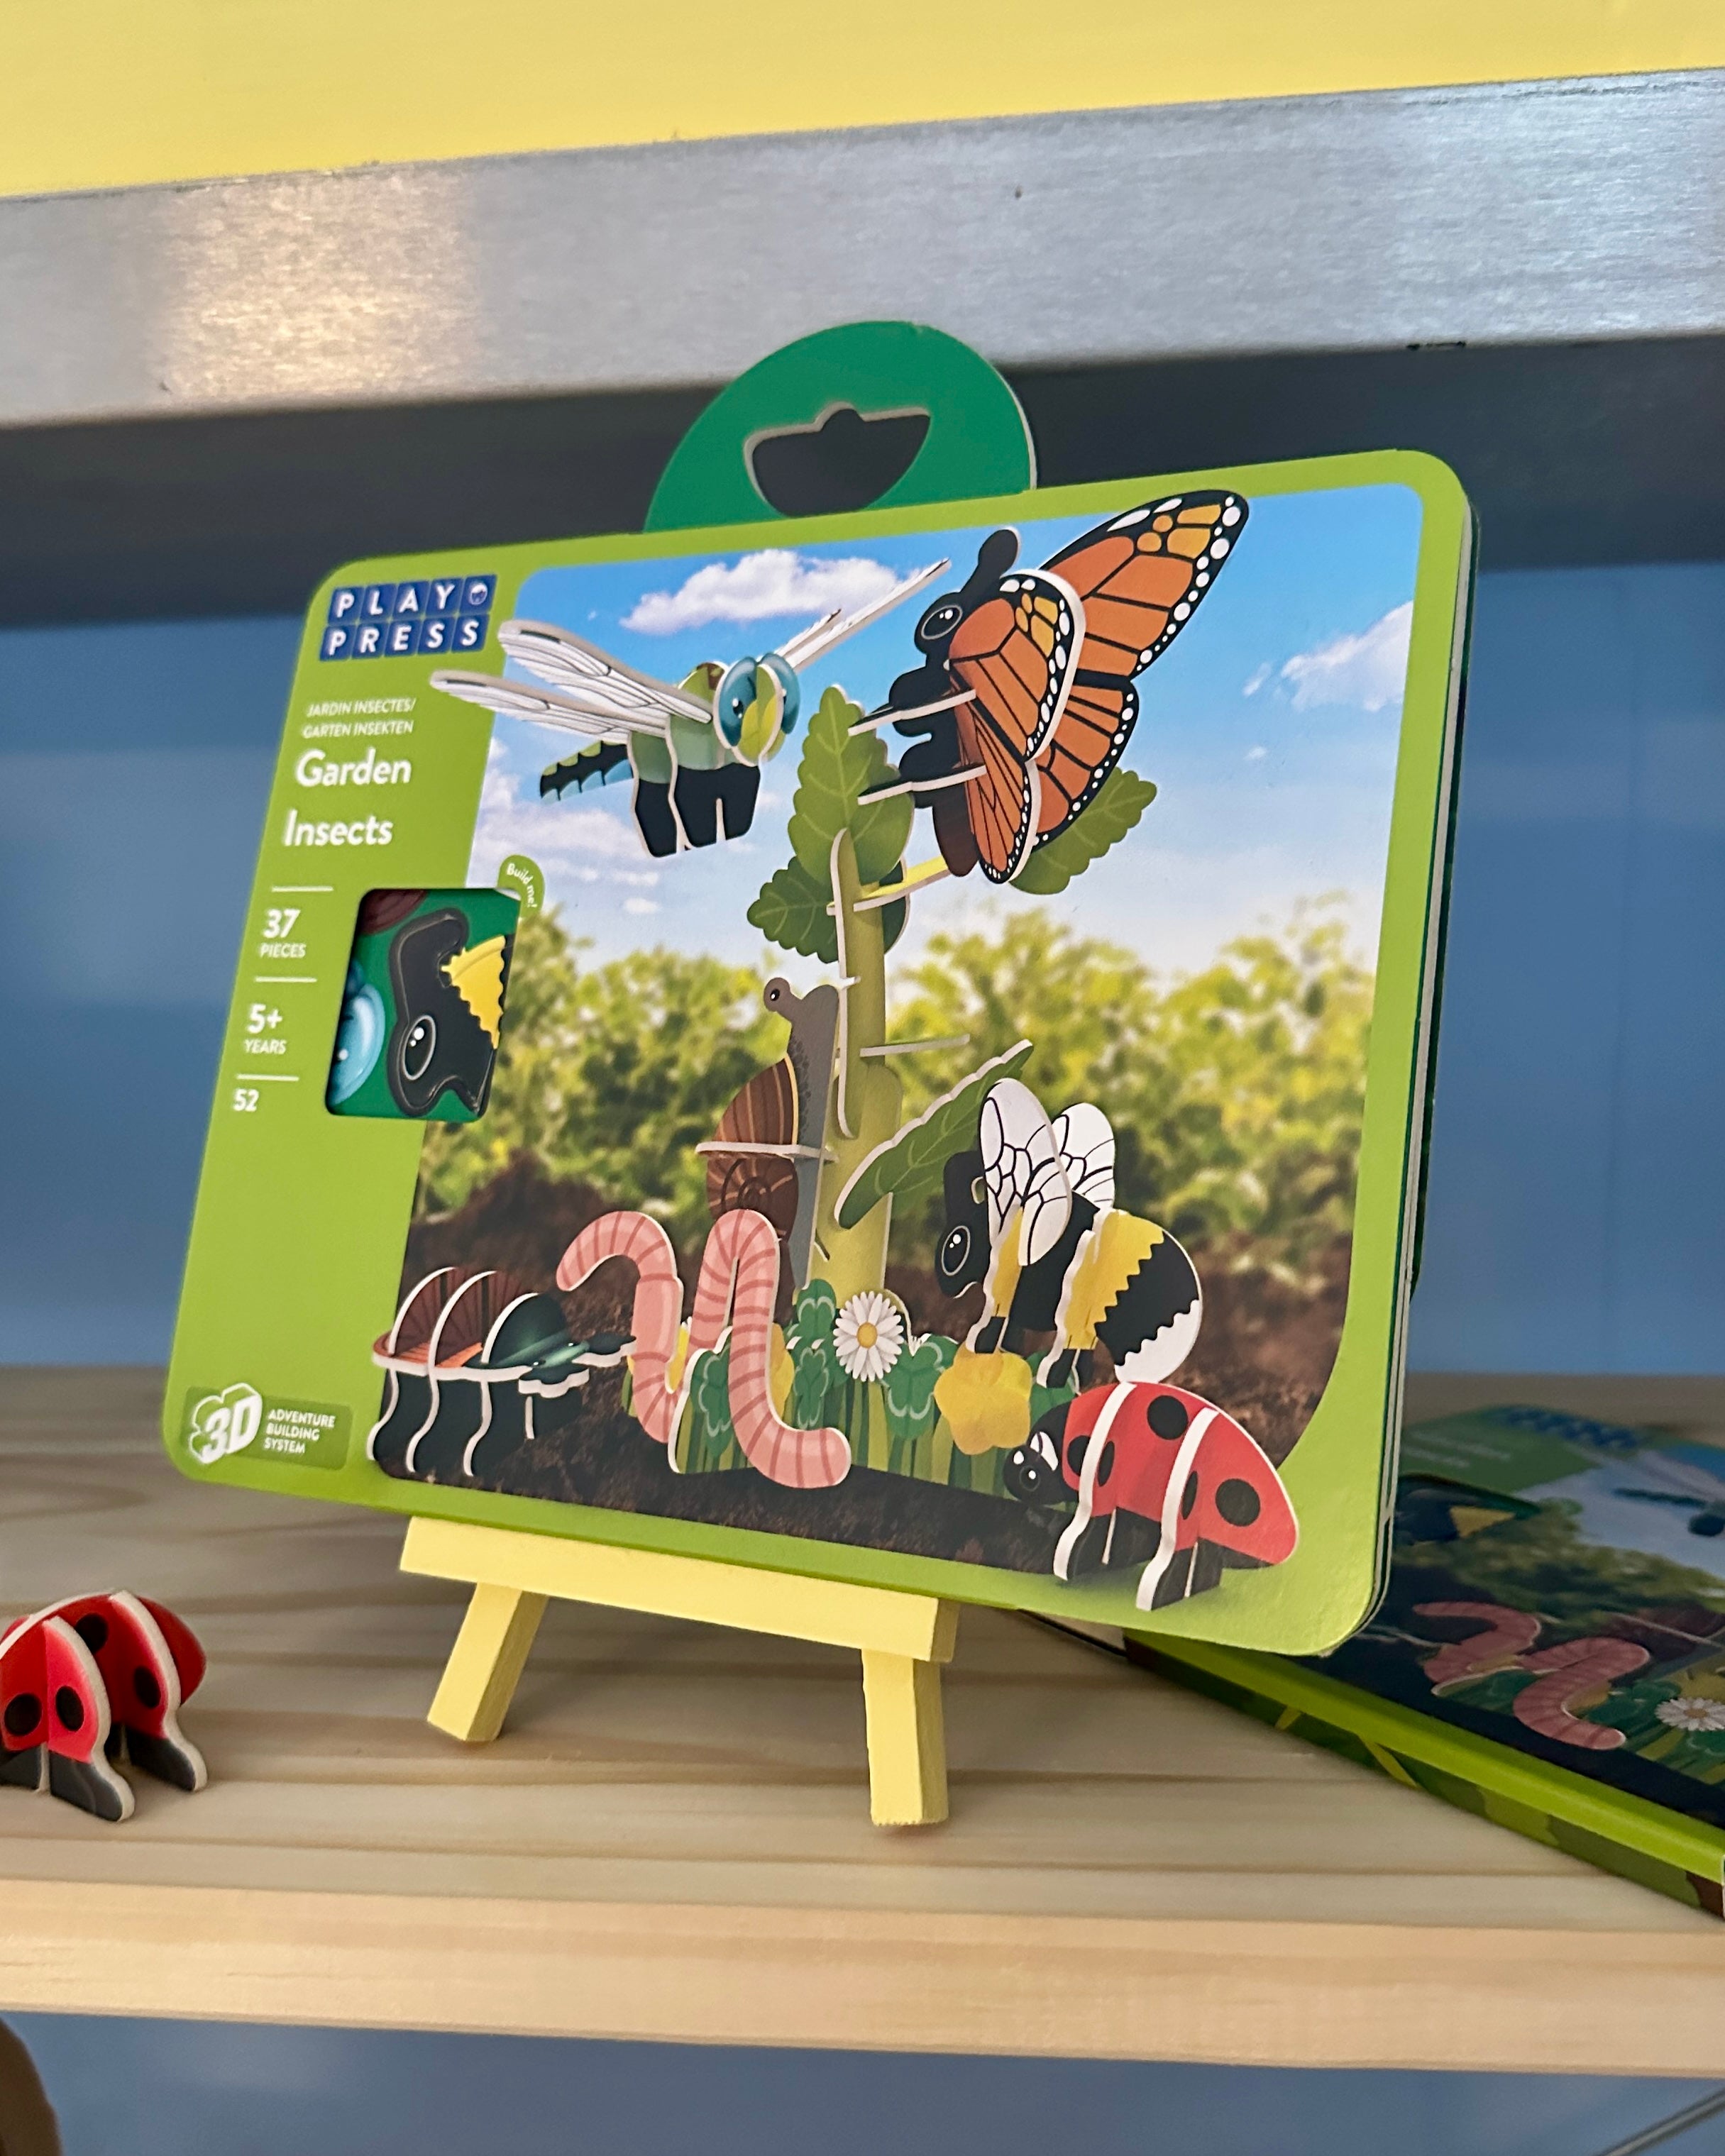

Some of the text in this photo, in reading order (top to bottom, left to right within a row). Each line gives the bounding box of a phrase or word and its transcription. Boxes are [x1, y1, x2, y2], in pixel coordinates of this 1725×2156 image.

[336, 583, 455, 618] PLAY
[328, 619, 480, 656] PRESS
[307, 697, 417, 717] JARDIN INSECTES/
[302, 720, 414, 739] GARTEN INSEKTEN
[295, 747, 412, 787] Garden
[282, 809, 394, 847] Insects
[506, 863, 534, 888] Build
[263, 909, 301, 939] 37
[260, 944, 306, 958] PIECES
[246, 1003, 282, 1034] 5+
[243, 1039, 287, 1054] YEARS
[233, 1088, 259, 1112] 52
[268, 1408, 336, 1427] ADVENTURE
[265, 1422, 320, 1442] BUILDING
[263, 1437, 306, 1454] SYSTEM
